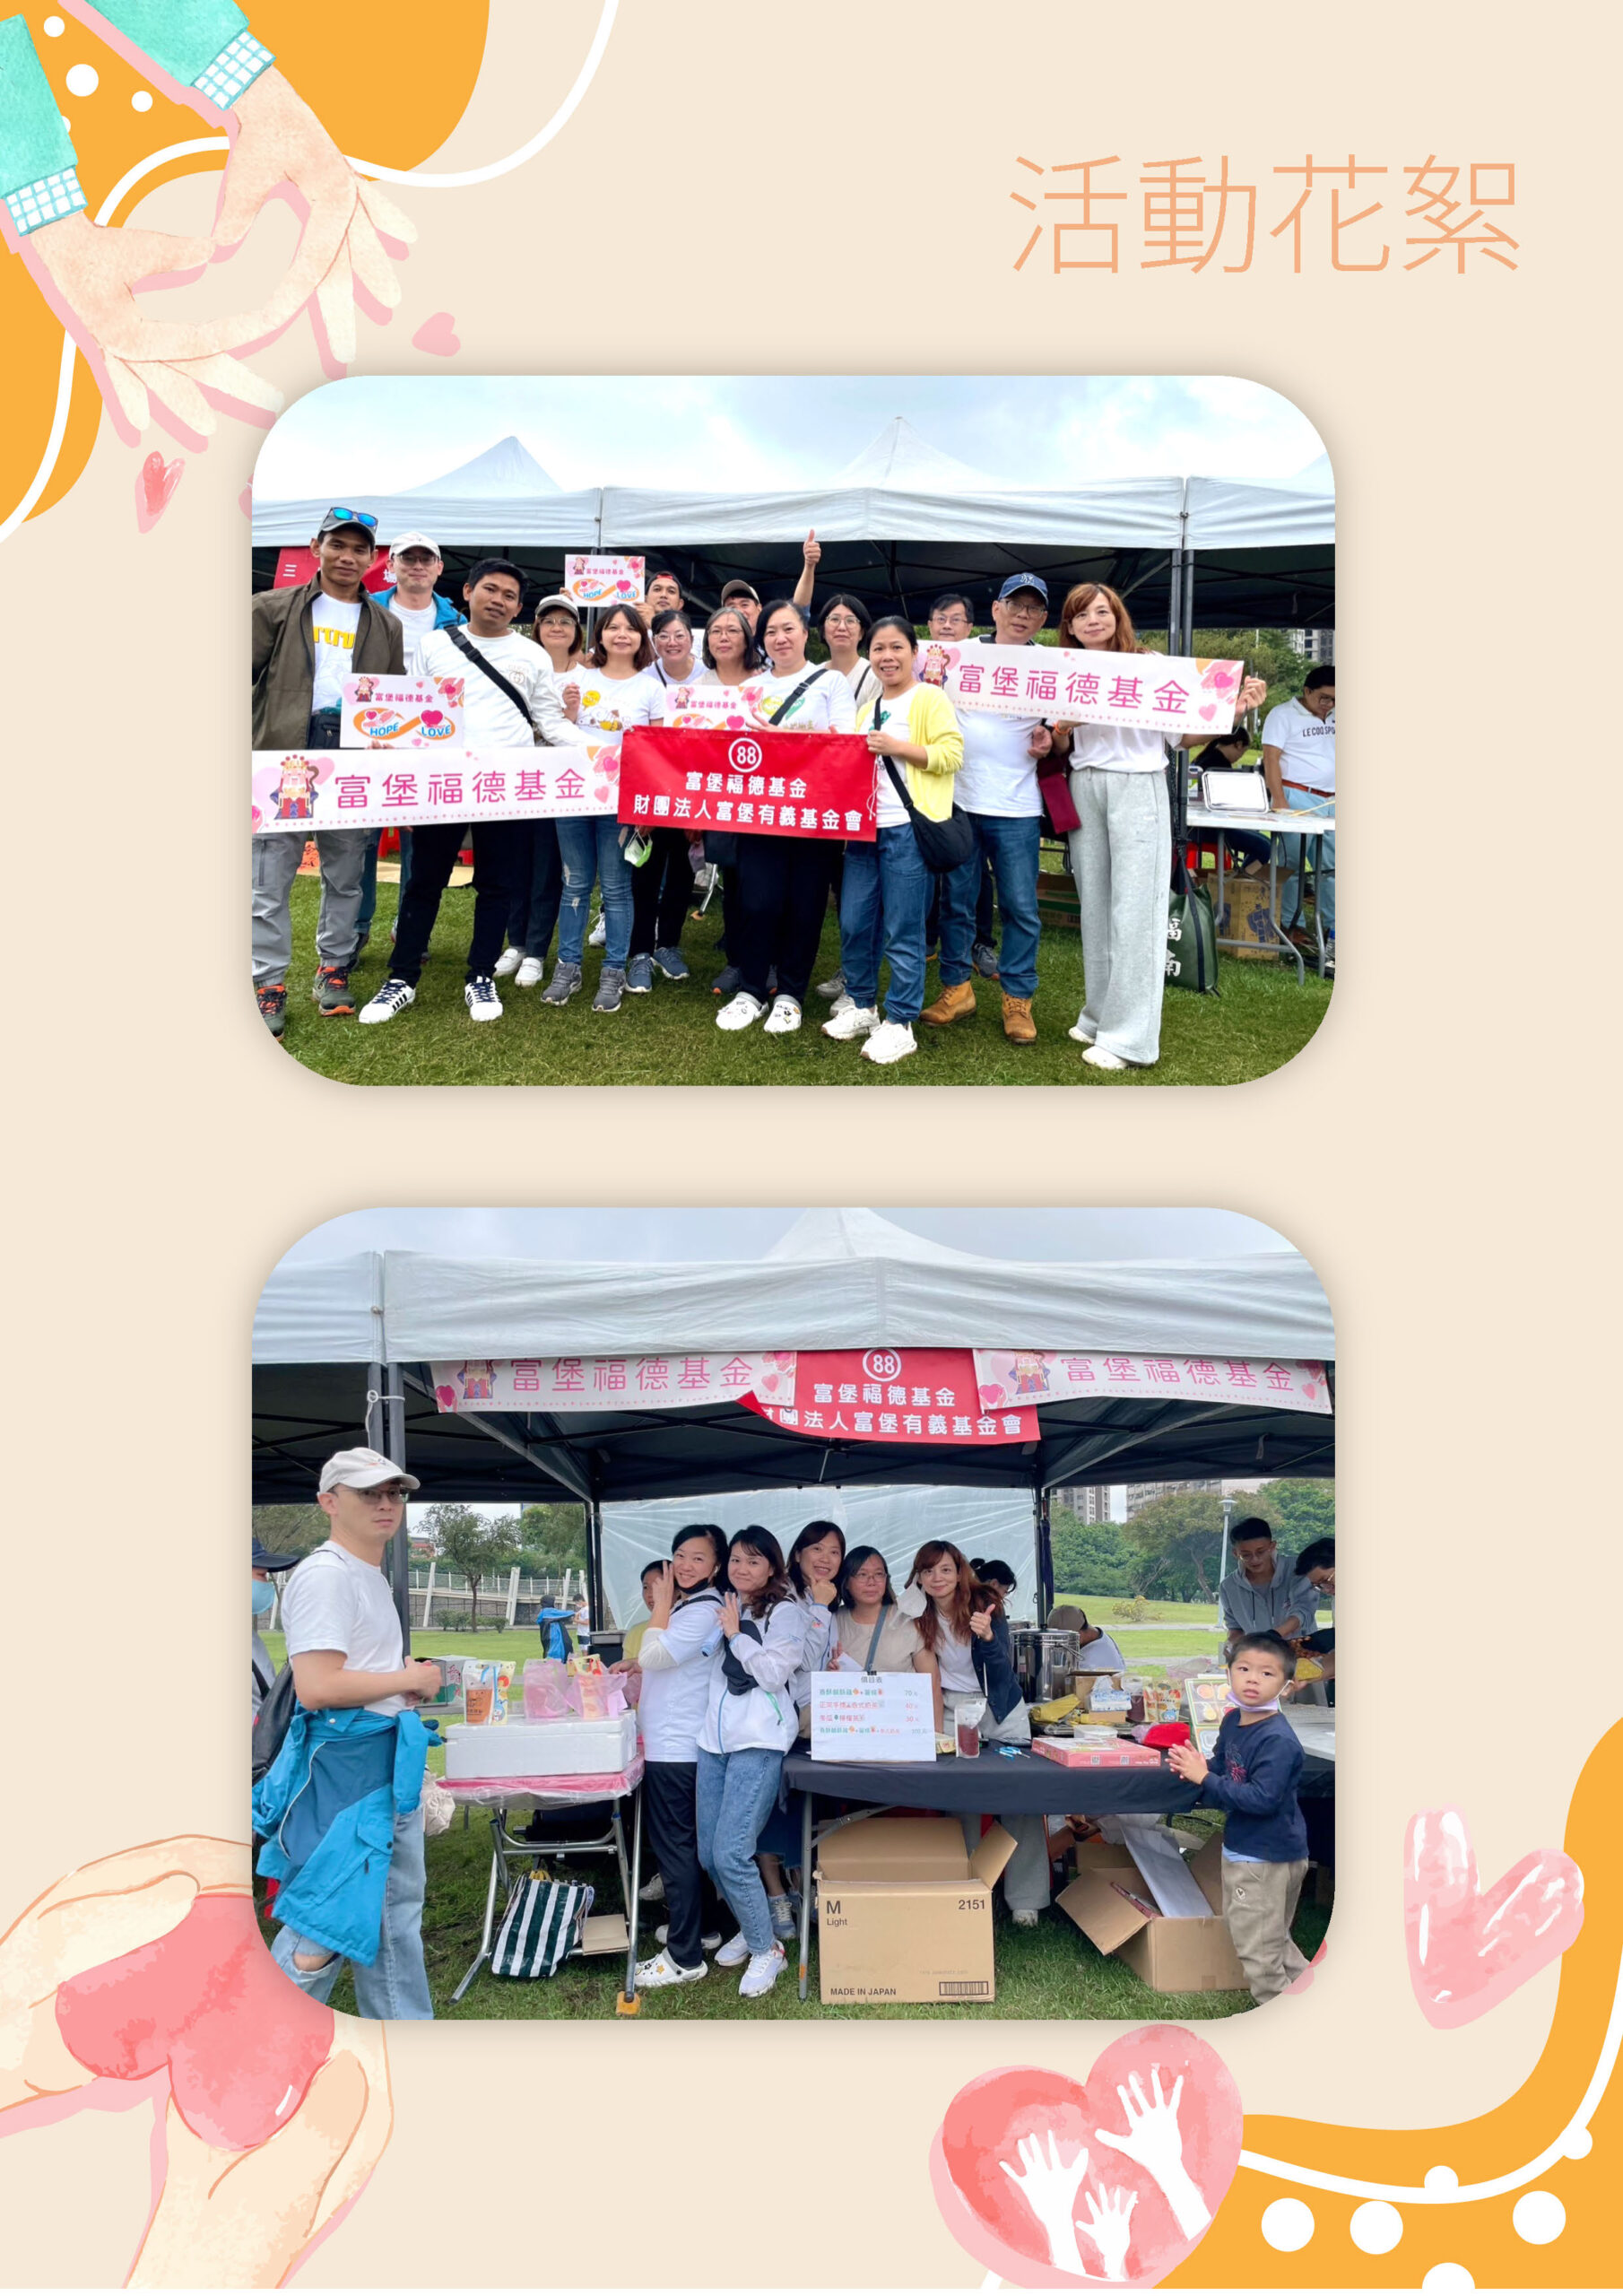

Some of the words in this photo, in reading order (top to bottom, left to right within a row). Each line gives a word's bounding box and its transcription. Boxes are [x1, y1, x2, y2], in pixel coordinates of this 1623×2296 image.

[583, 588, 603, 599] HOPE
[616, 590, 637, 599] LOVE
[375, 692, 434, 703] 富堡福德基金
[959, 663, 1191, 715] 富堡福德基金
[690, 700, 737, 709] 富堡福德基金
[369, 722, 399, 736] HOPE
[421, 725, 452, 737] LOVE
[736, 745, 757, 765] 88
[334, 768, 586, 809] 富堡福德基金
[685, 770, 808, 799] 富堡福德基金
[633, 795, 863, 831] 財團法人富堡有義基金會
[872, 1353, 895, 1374] 88
[510, 1356, 755, 1393] 富堡福德基金
[1060, 1357, 1295, 1392] 富堡福德基金
[813, 1383, 956, 1407] 富堡福德基金
[826, 1900, 841, 1915] M
[958, 1899, 985, 1910] 2151
[827, 1918, 848, 1927] Light
[830, 1987, 855, 1996] MADE
[857, 1987, 866, 1996] IN
[868, 1987, 897, 1996] JAPAN
